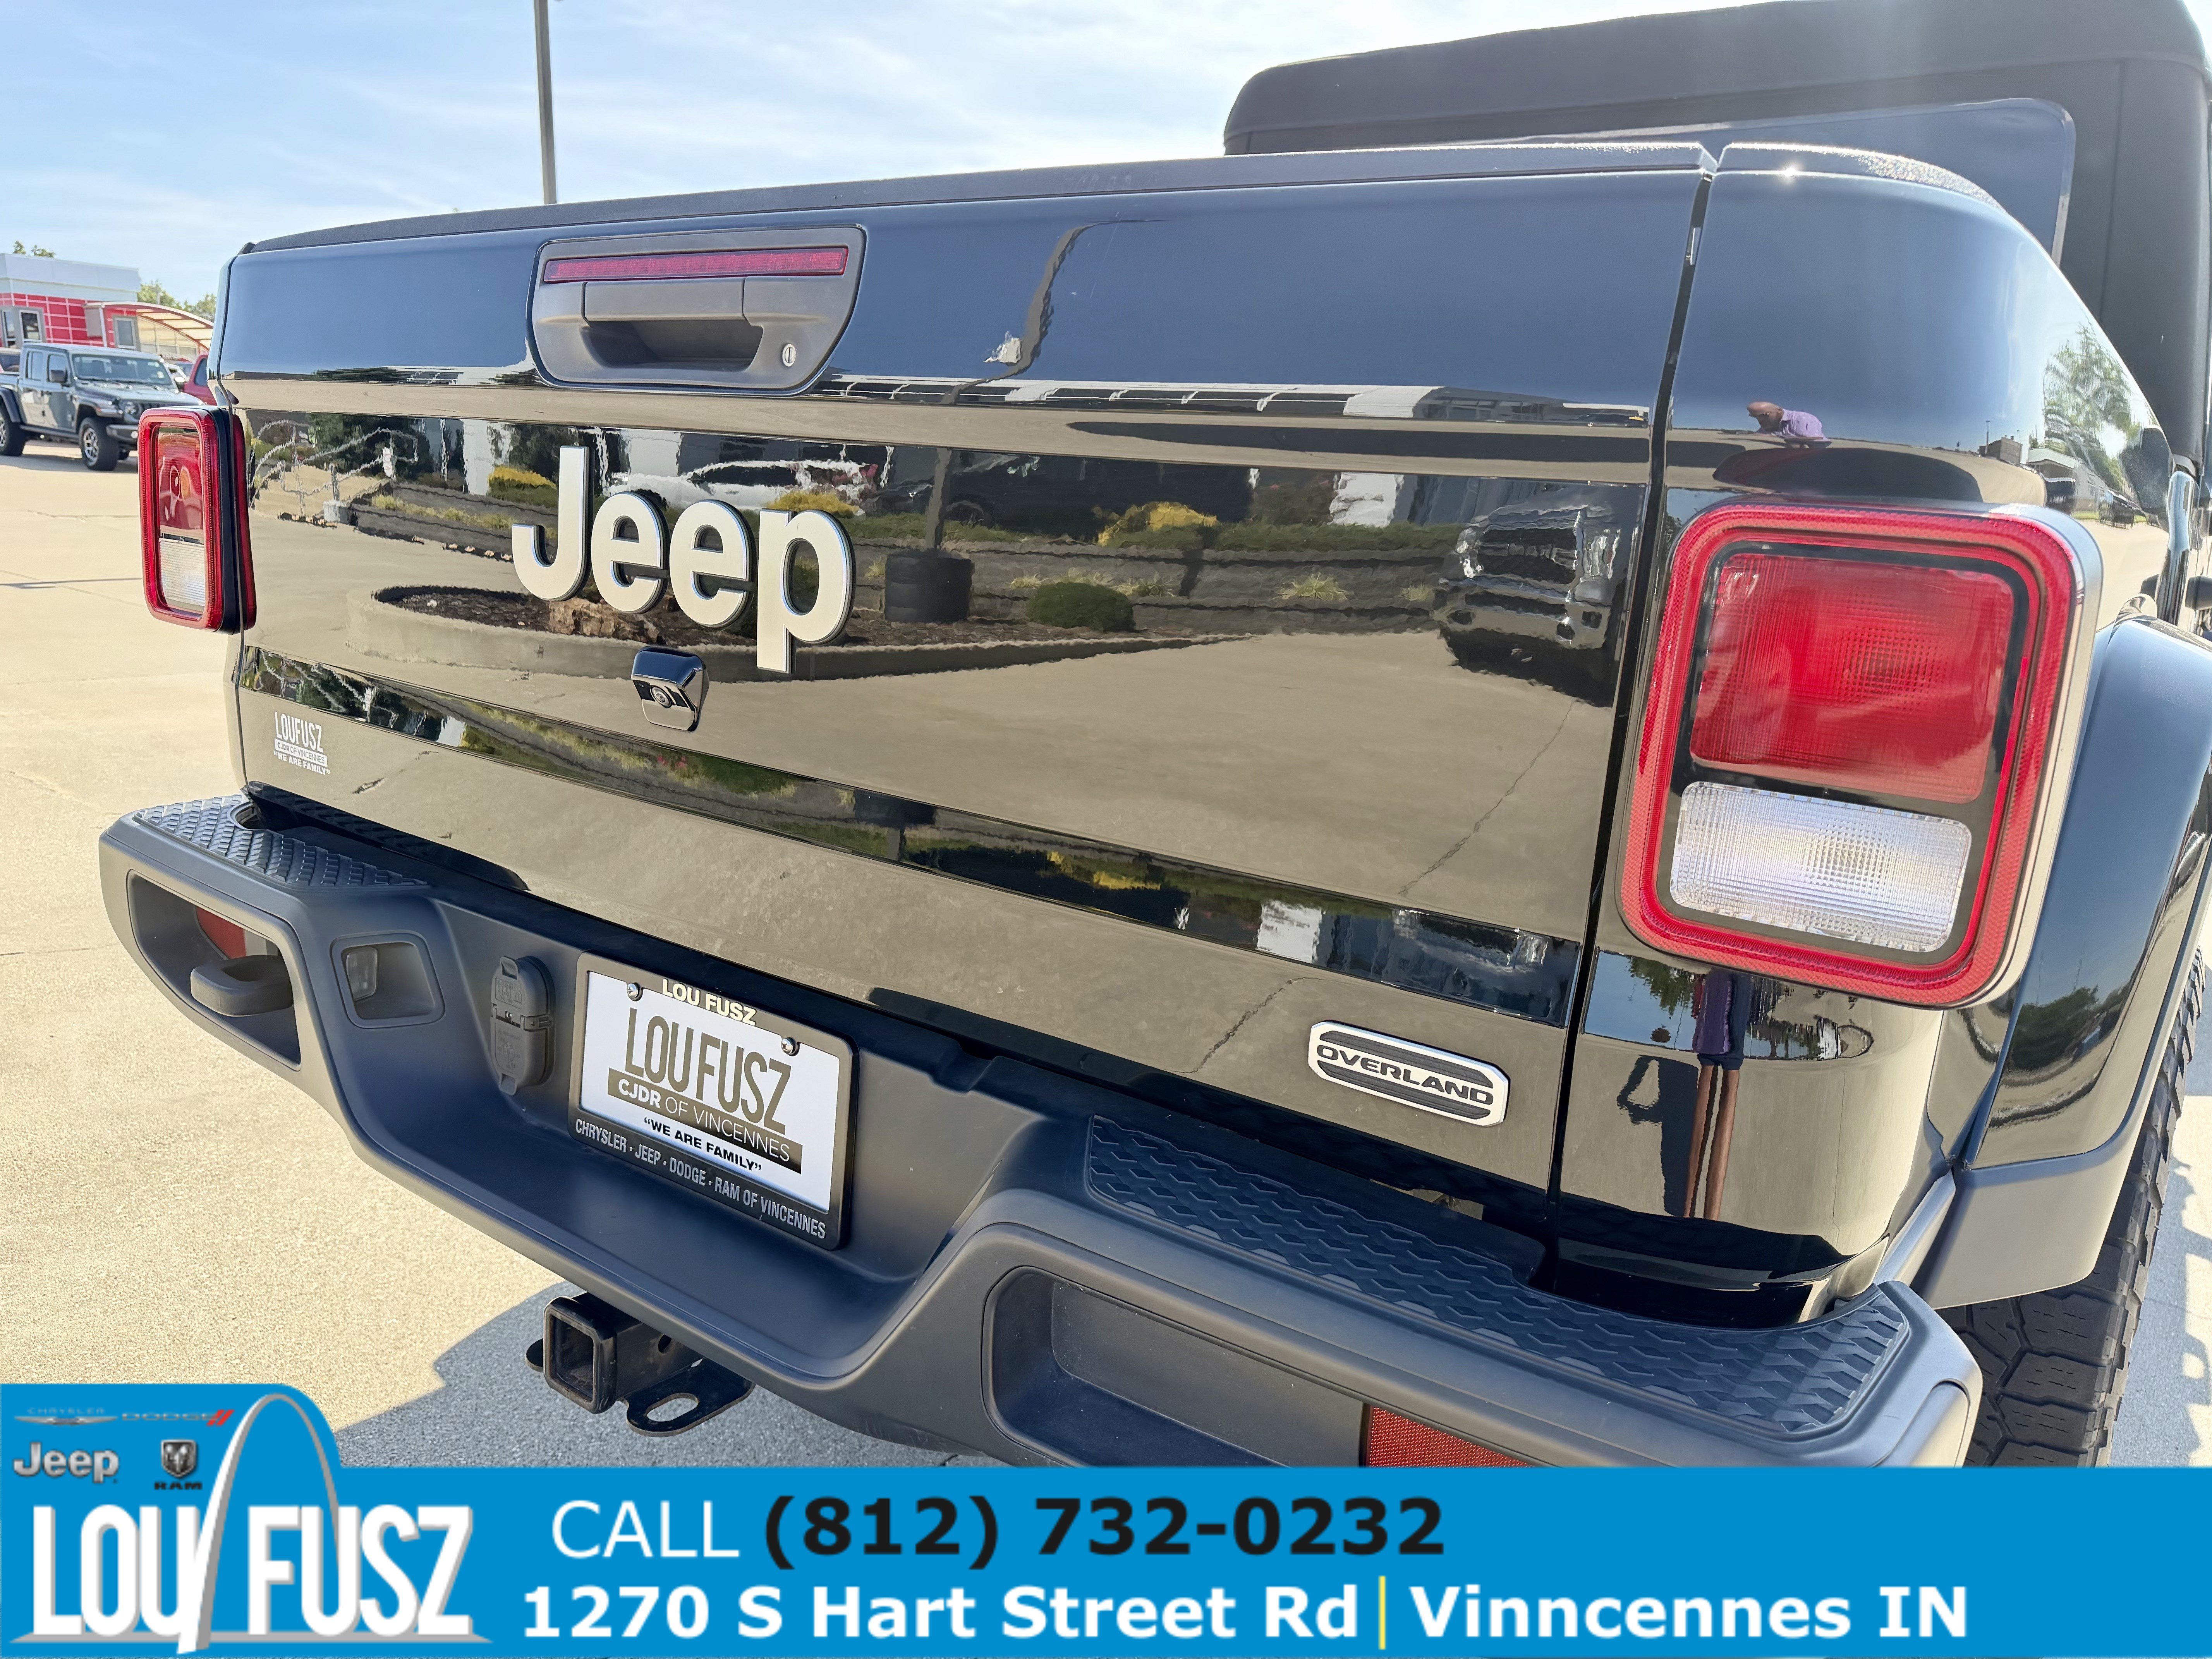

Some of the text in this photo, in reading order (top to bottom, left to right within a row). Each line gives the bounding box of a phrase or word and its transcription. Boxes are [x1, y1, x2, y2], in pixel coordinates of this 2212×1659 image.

[512, 445, 856, 674] Jeep
[277, 742, 289, 751] CJDR
[298, 748, 325, 764] VINCENNES
[289, 756, 302, 767] ARE
[662, 979, 756, 1026] LOU FUSZ
[625, 1007, 694, 1092] LOU
[696, 1032, 792, 1135] FUSZ
[1316, 1044, 1494, 1105] OVERLAND
[618, 1079, 790, 1162] CJDR OF VINCENNES
[674, 1130, 702, 1149] ARE
[575, 1118, 826, 1239] CHRYSLER JEEP DODGE RAM OF VINCENNES
